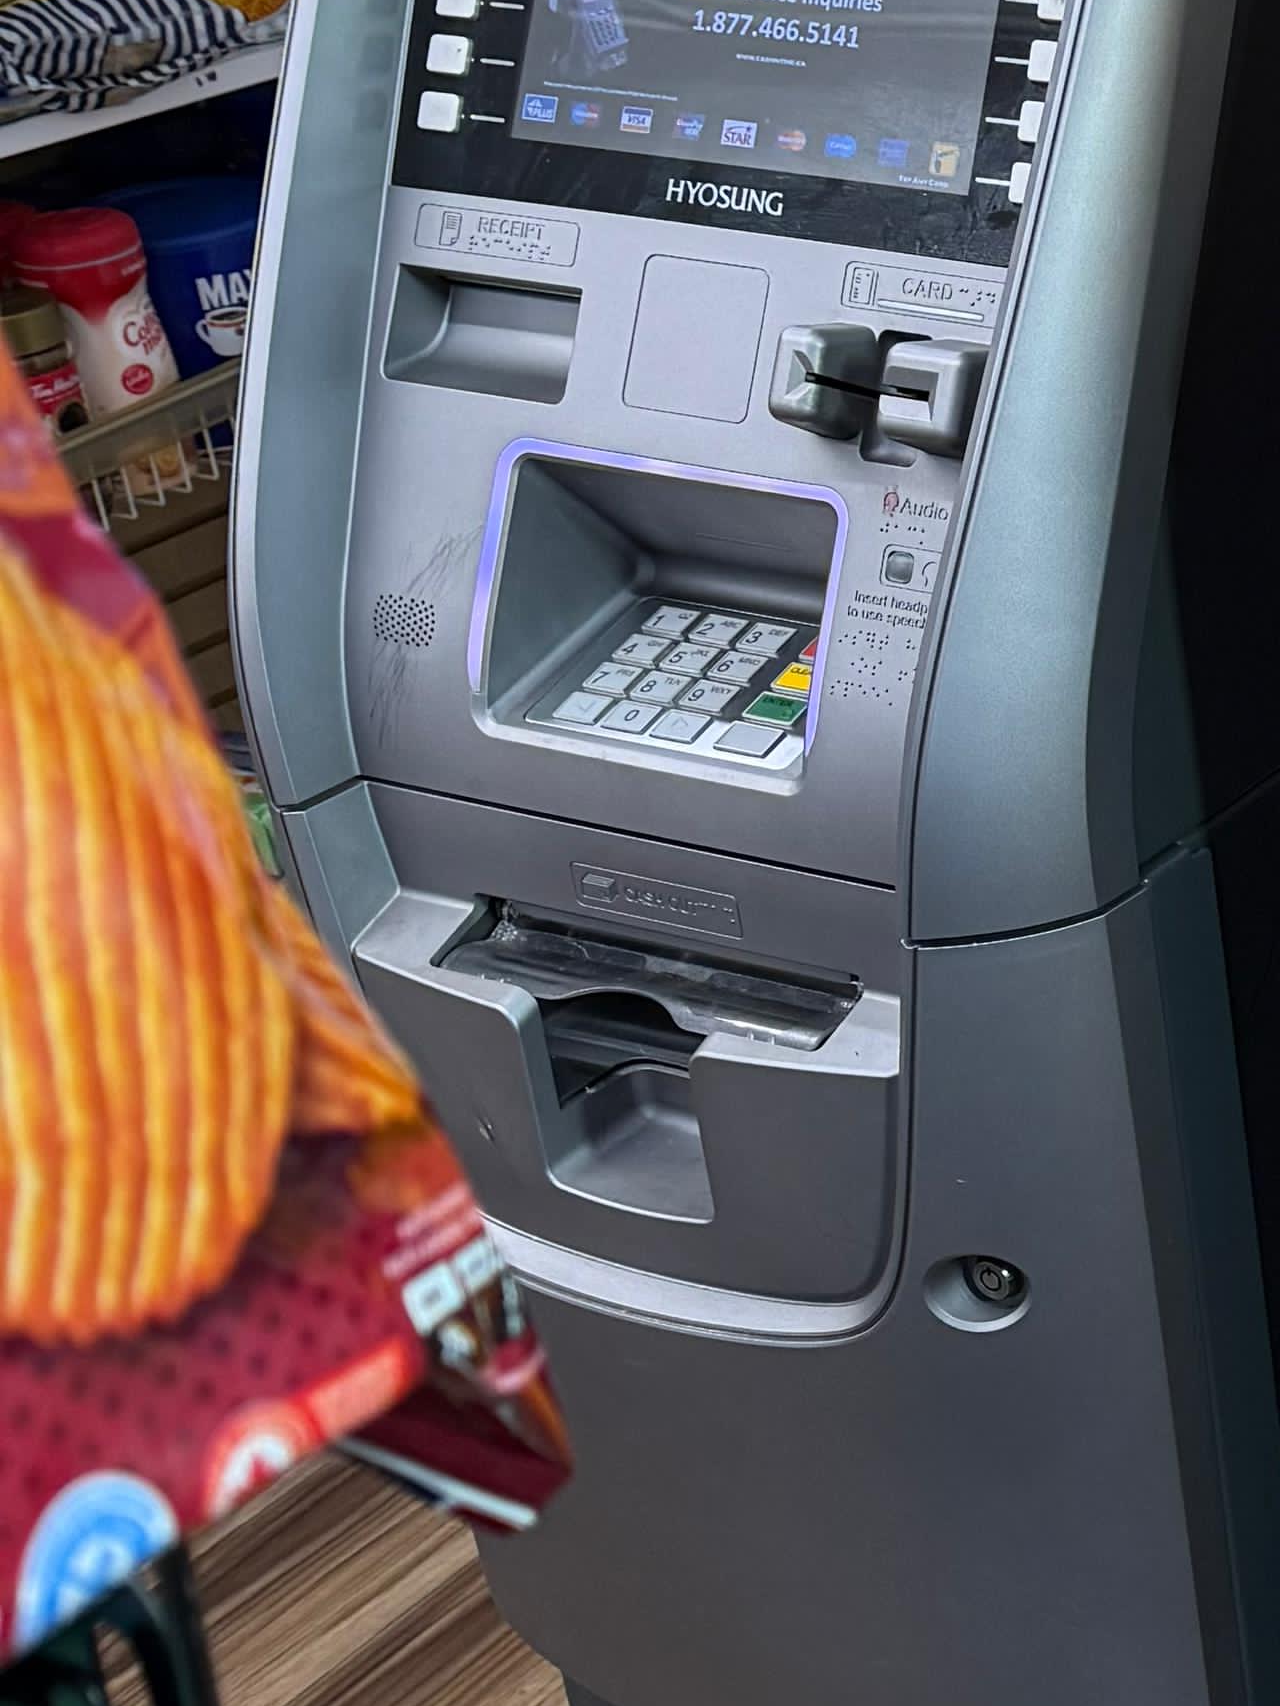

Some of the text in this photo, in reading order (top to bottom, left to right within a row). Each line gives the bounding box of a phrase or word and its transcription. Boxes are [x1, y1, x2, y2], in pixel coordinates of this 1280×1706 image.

[692, 9, 859, 49] 1.877.466.5141
[666, 179, 784, 216] HYOSUNG
[477, 217, 545, 242] RECEIPT
[902, 277, 952, 301] CARD
[900, 498, 949, 521] Audio
